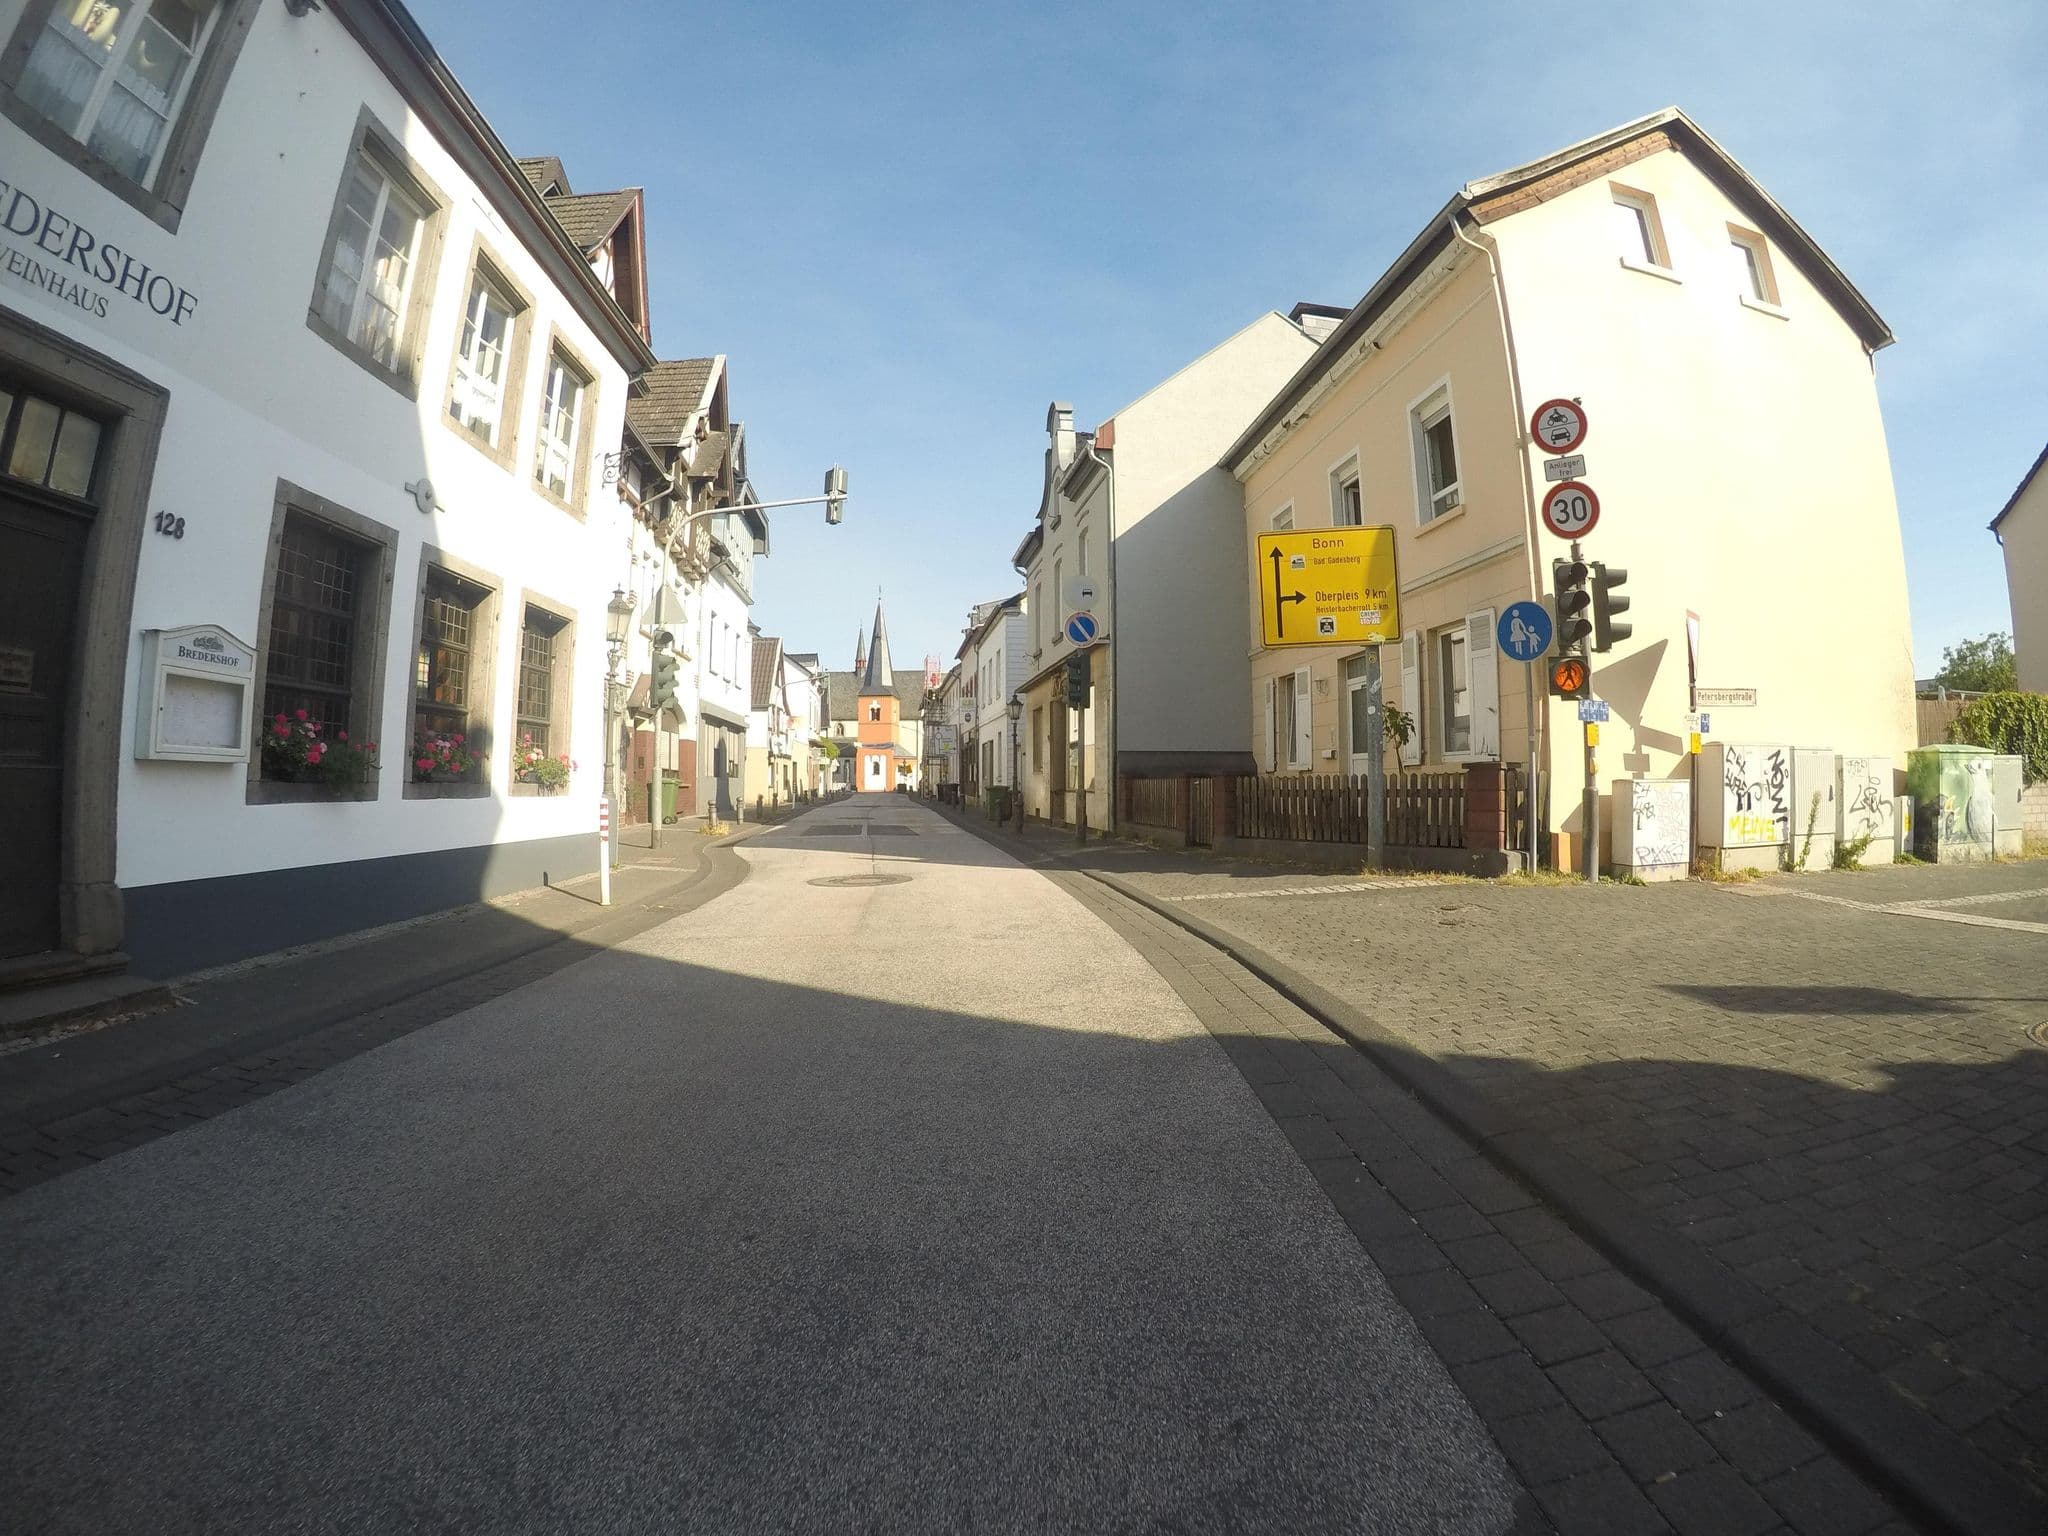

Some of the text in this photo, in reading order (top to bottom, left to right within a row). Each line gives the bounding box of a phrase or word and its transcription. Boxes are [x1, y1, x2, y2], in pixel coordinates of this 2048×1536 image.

[1549, 459, 1580, 470] Anlieger
[1559, 469, 1572, 477] frei
[1554, 496, 1588, 524] 30
[154, 510, 186, 540] 128
[1312, 538, 1344, 549] Bonn
[1313, 557, 1325, 566] Bad
[1315, 588, 1387, 603] Oberpleis 9 km
[178, 645, 240, 667] BREDERSHOF
[1697, 691, 1753, 703] Petersbergstraße
